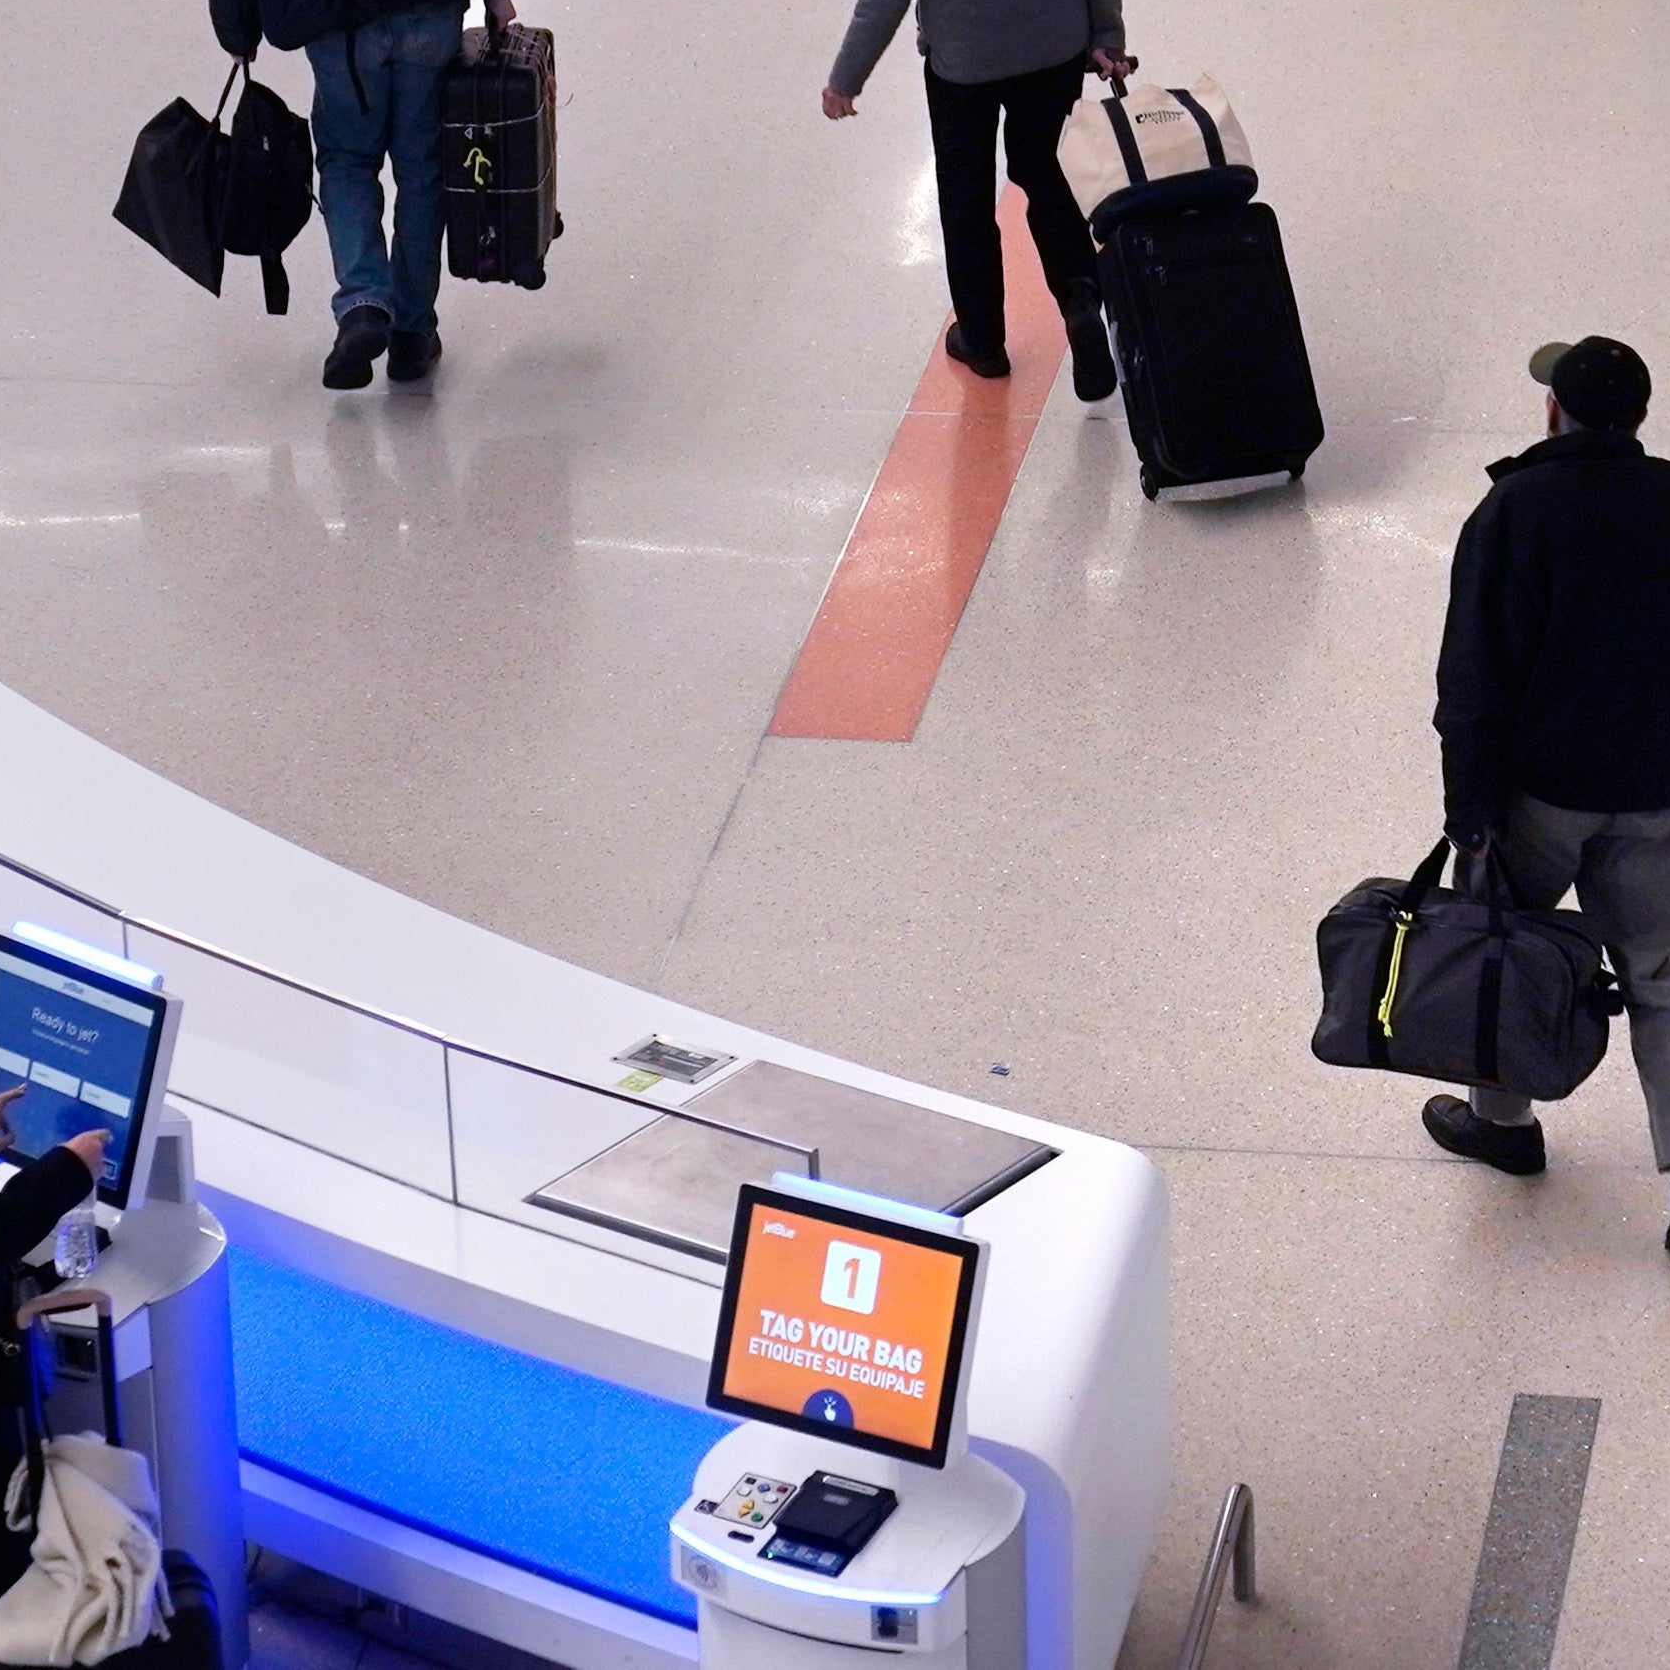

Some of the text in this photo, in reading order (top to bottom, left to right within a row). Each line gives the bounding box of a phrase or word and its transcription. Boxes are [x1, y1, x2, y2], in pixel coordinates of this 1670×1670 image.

[31, 1006, 64, 1033] Ready
[66, 1019, 79, 1037] to
[76, 1025, 99, 1043] jet?
[843, 1257, 861, 1300] 1
[748, 1336, 926, 1400] ETIQUETE SU EQUIPAJE
[759, 1309, 924, 1375] TAG YOUR BAG
